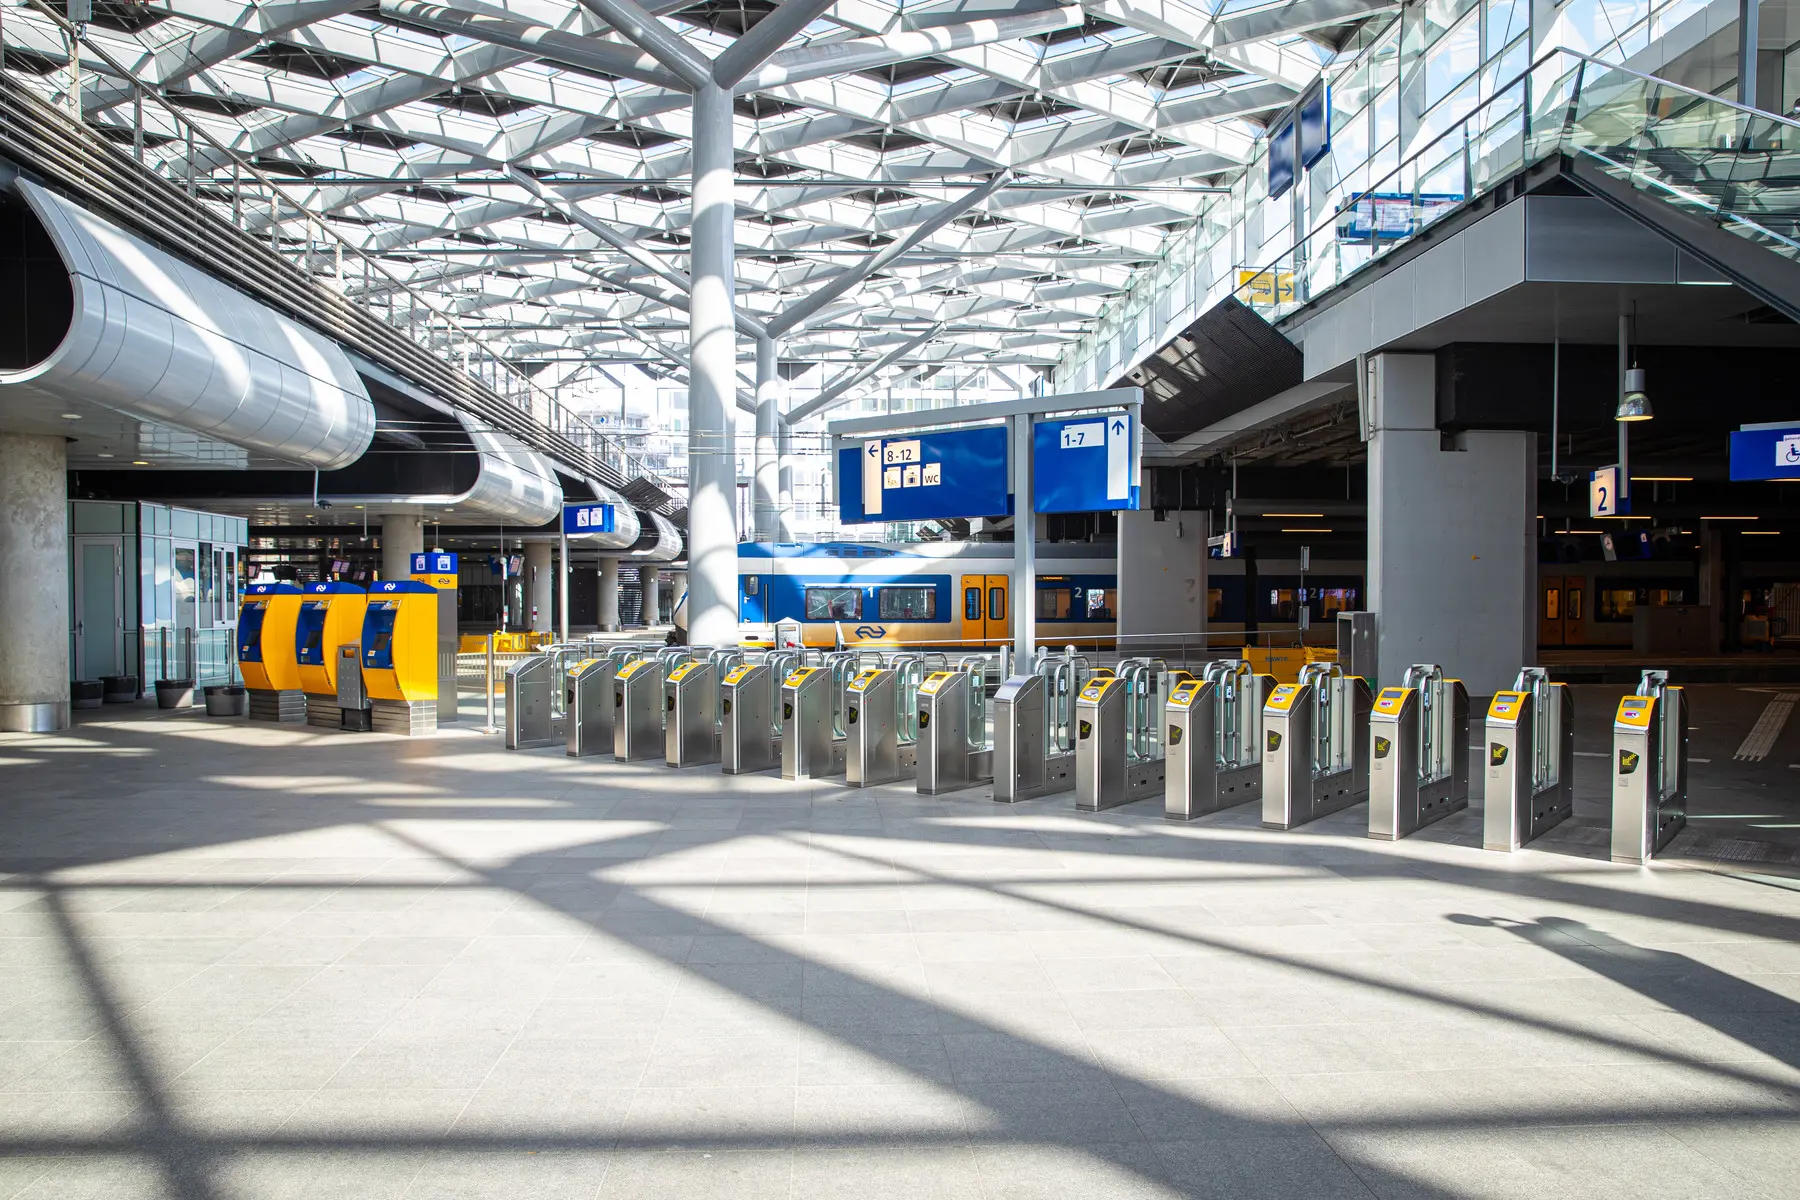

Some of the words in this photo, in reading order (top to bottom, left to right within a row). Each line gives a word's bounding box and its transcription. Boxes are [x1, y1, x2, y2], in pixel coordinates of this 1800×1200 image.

[1064, 432, 1085, 446] 1-7
[887, 449, 912, 462] 8-12
[924, 474, 939, 484] WC
[1597, 486, 1607, 512] 2
[867, 586, 874, 598] 1
[1074, 586, 1082, 598] 2
[1310, 587, 1317, 599] 2
